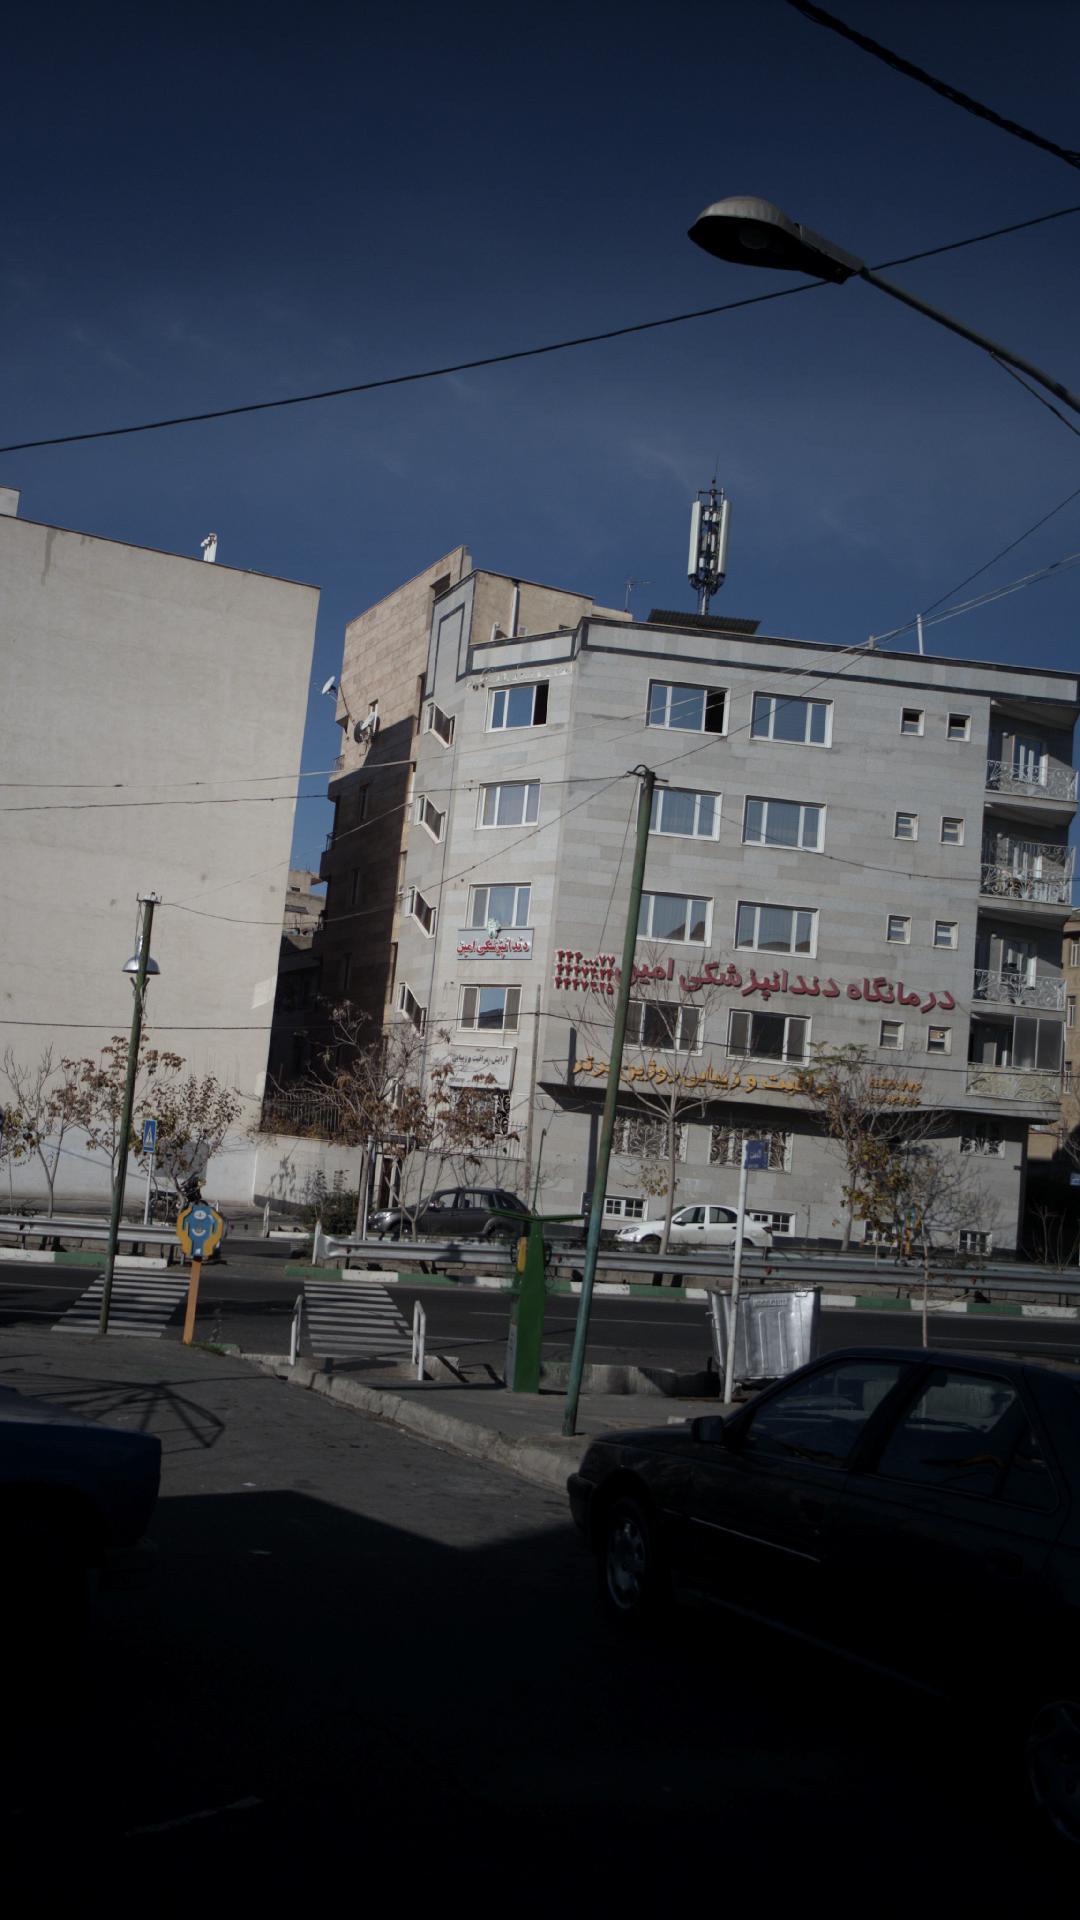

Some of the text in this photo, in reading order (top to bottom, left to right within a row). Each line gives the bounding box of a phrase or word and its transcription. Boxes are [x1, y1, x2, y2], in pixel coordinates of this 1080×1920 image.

[456, 941, 476, 958] امین
[679, 960, 841, 1001] دندانپزشکی
[847, 976, 956, 1014] درمانگاه
[744, 1073, 758, 1093] و
